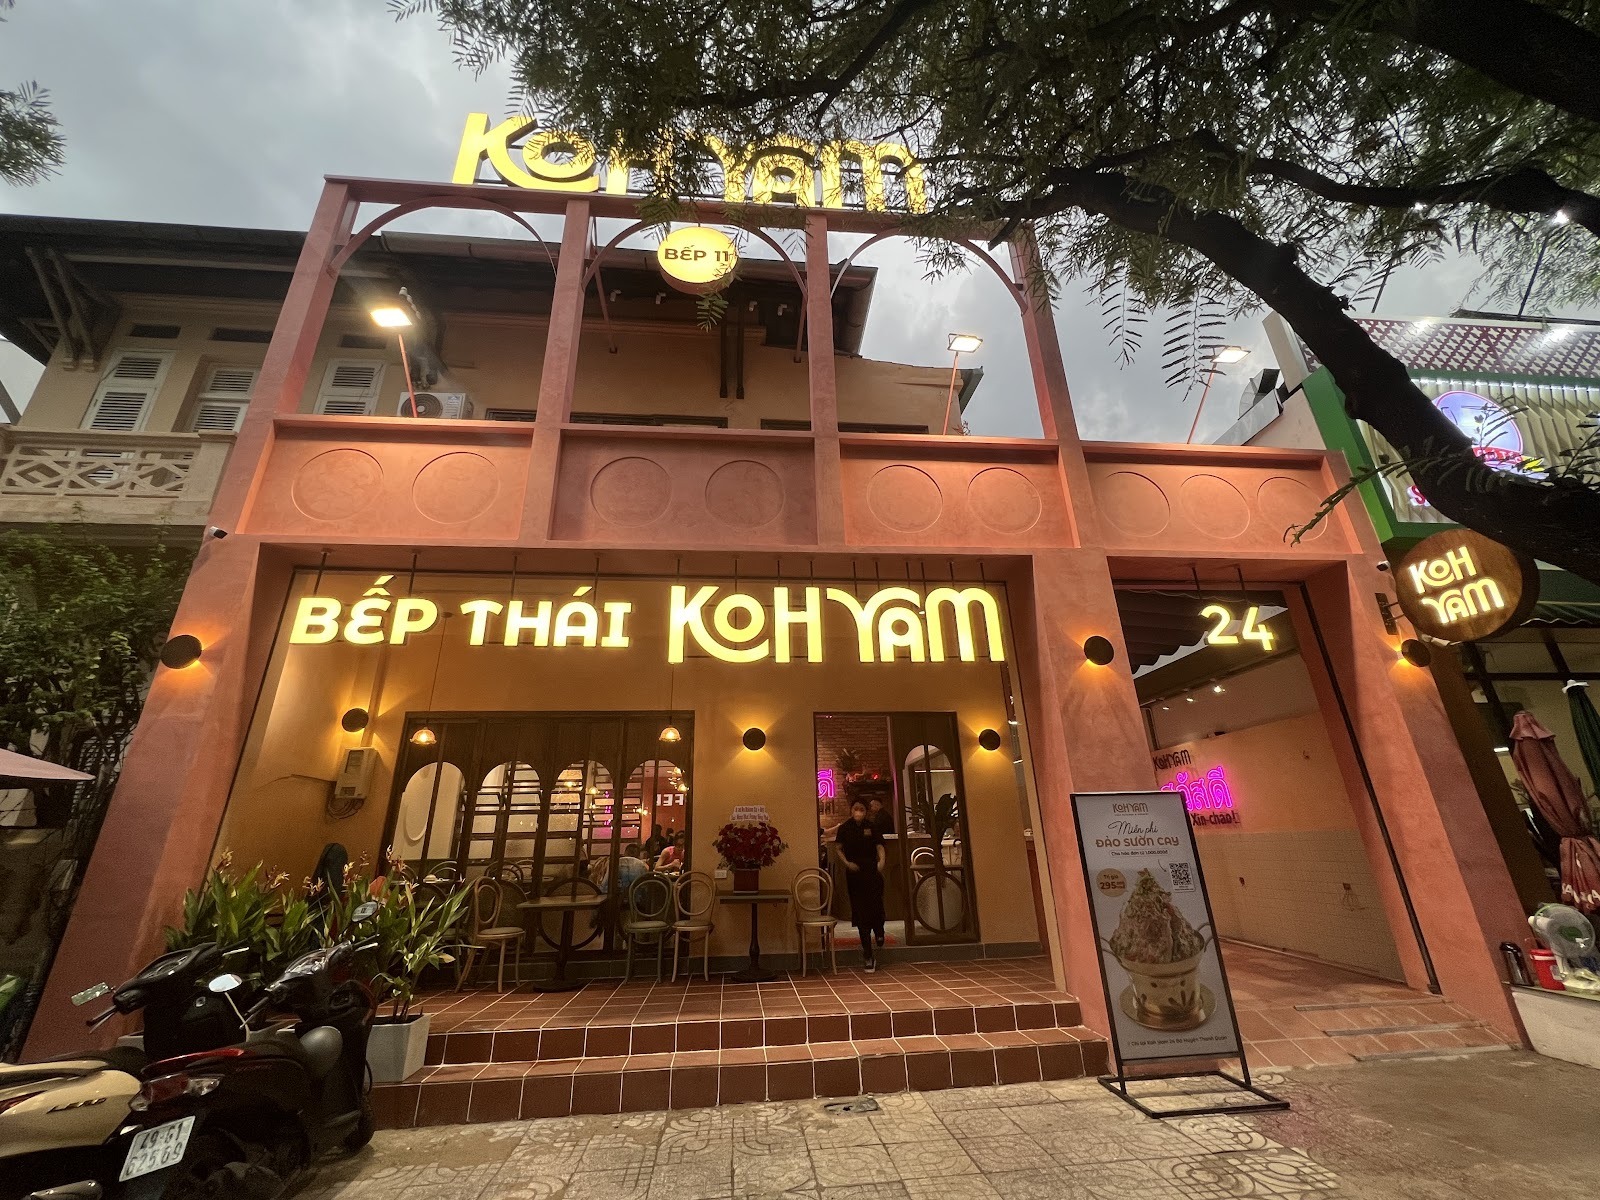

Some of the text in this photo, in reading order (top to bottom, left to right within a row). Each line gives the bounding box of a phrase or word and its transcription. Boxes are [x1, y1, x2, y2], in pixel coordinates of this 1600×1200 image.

[664, 245, 707, 261] BẾP
[1408, 545, 1477, 594] KOH
[289, 575, 438, 645] BẾP
[460, 586, 632, 648] THÁI
[1421, 577, 1505, 625] YAM
[1200, 605, 1274, 651] 24
